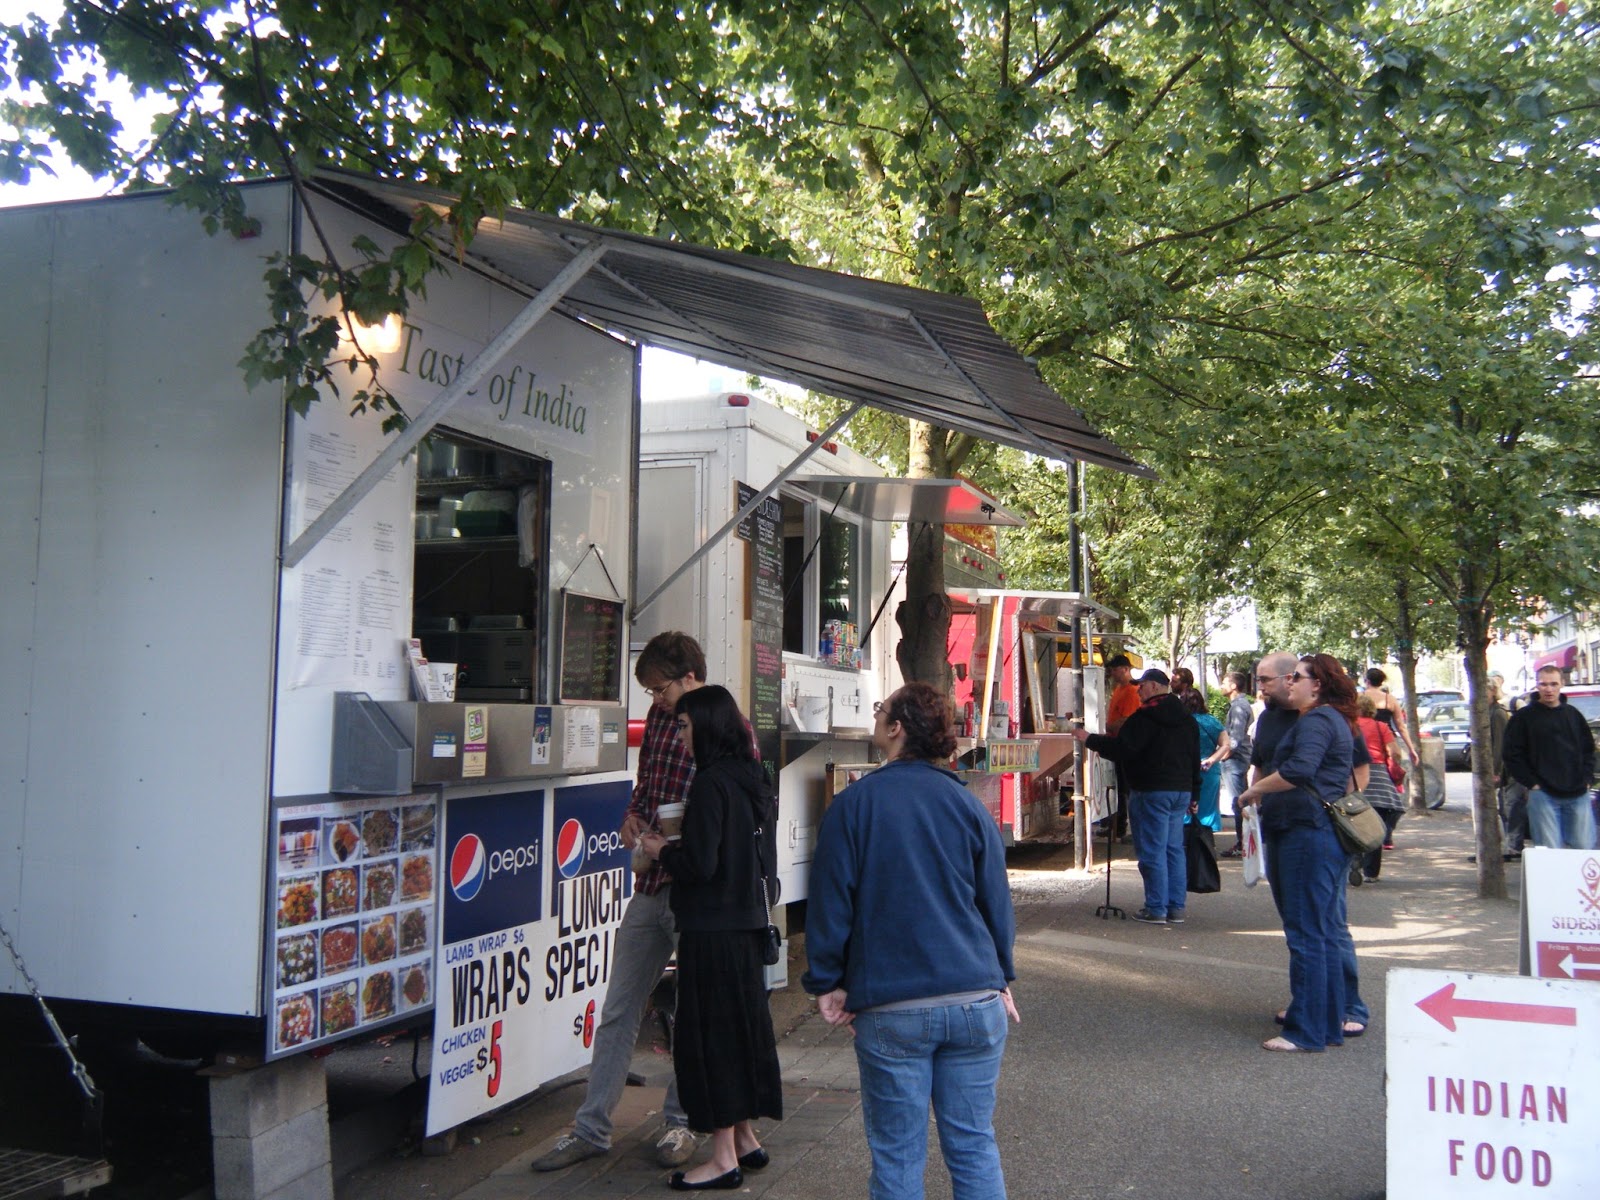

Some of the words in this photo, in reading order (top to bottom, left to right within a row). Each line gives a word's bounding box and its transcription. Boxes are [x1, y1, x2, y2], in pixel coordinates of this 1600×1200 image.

[398, 321, 478, 396] Tast
[489, 365, 522, 421] of
[522, 372, 587, 435] India
[537, 746, 546, 758] $1
[489, 838, 539, 880] pepsi
[587, 831, 625, 861] peps
[559, 868, 622, 938] LUNCH
[446, 943, 474, 964] LAMB
[478, 933, 507, 954] WRAP
[513, 928, 524, 945] $6
[452, 946, 531, 1028] WRAPS
[545, 928, 619, 1002] SPECI
[442, 1025, 487, 1055] CHICKEN
[573, 998, 595, 1049] $6
[440, 1059, 475, 1086] VEGGIE
[476, 1019, 503, 1098] $5
[1427, 1075, 1568, 1124] INDIAN
[1448, 1139, 1553, 1188] FOOD
